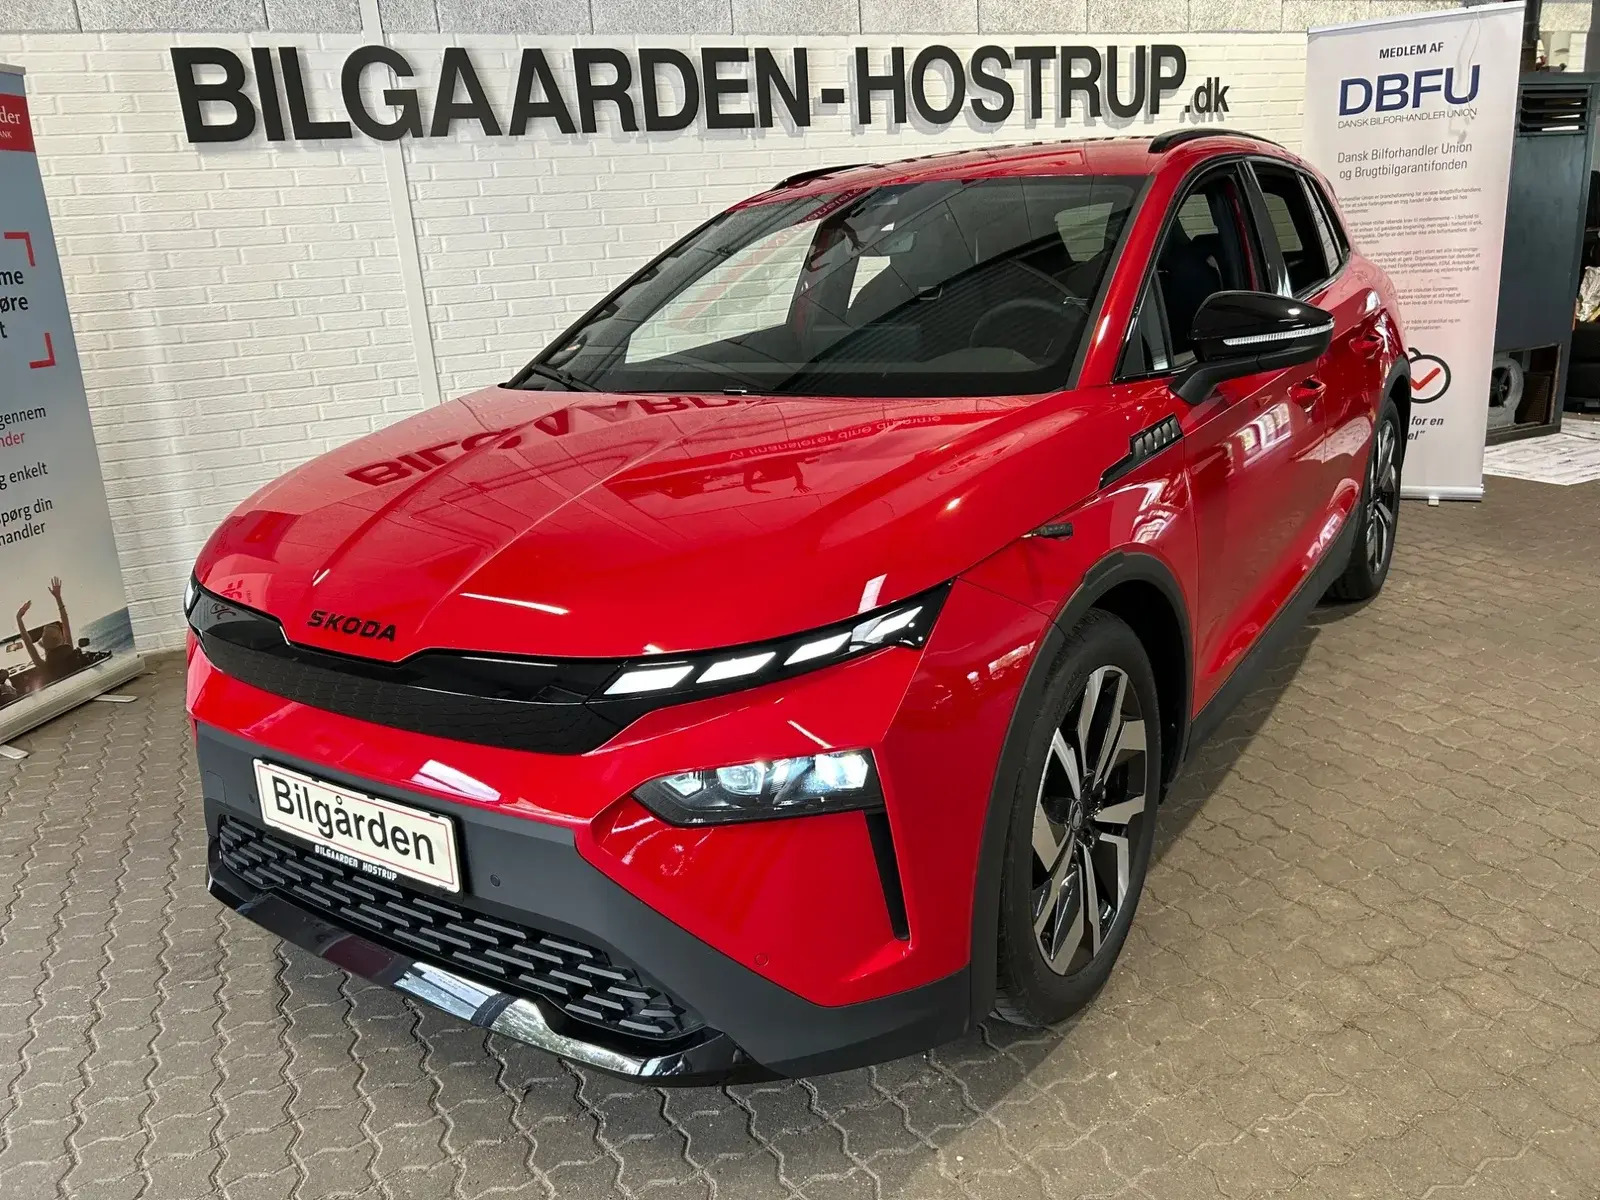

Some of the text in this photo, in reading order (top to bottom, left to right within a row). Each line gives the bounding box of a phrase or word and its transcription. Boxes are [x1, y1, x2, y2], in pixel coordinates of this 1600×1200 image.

[1379, 41, 1444, 59] MEDLEM AF
[1338, 64, 1481, 116] DBFU
[1337, 107, 1478, 129] DANSK BILFORHANDLER UNION
[1337, 141, 1473, 164] Dansk Bilforhandler Union
[1339, 159, 1468, 181] og Brugtbilgarantifonden
[0, 296, 29, 313] øre
[0, 407, 47, 431] gennem
[1411, 415, 1444, 426] for en
[9, 461, 48, 483] enkelt
[0, 497, 54, 527] pørg din
[271, 774, 436, 866] Bilgården
[314, 844, 398, 881] BILGAARDEN HOSTRUP
